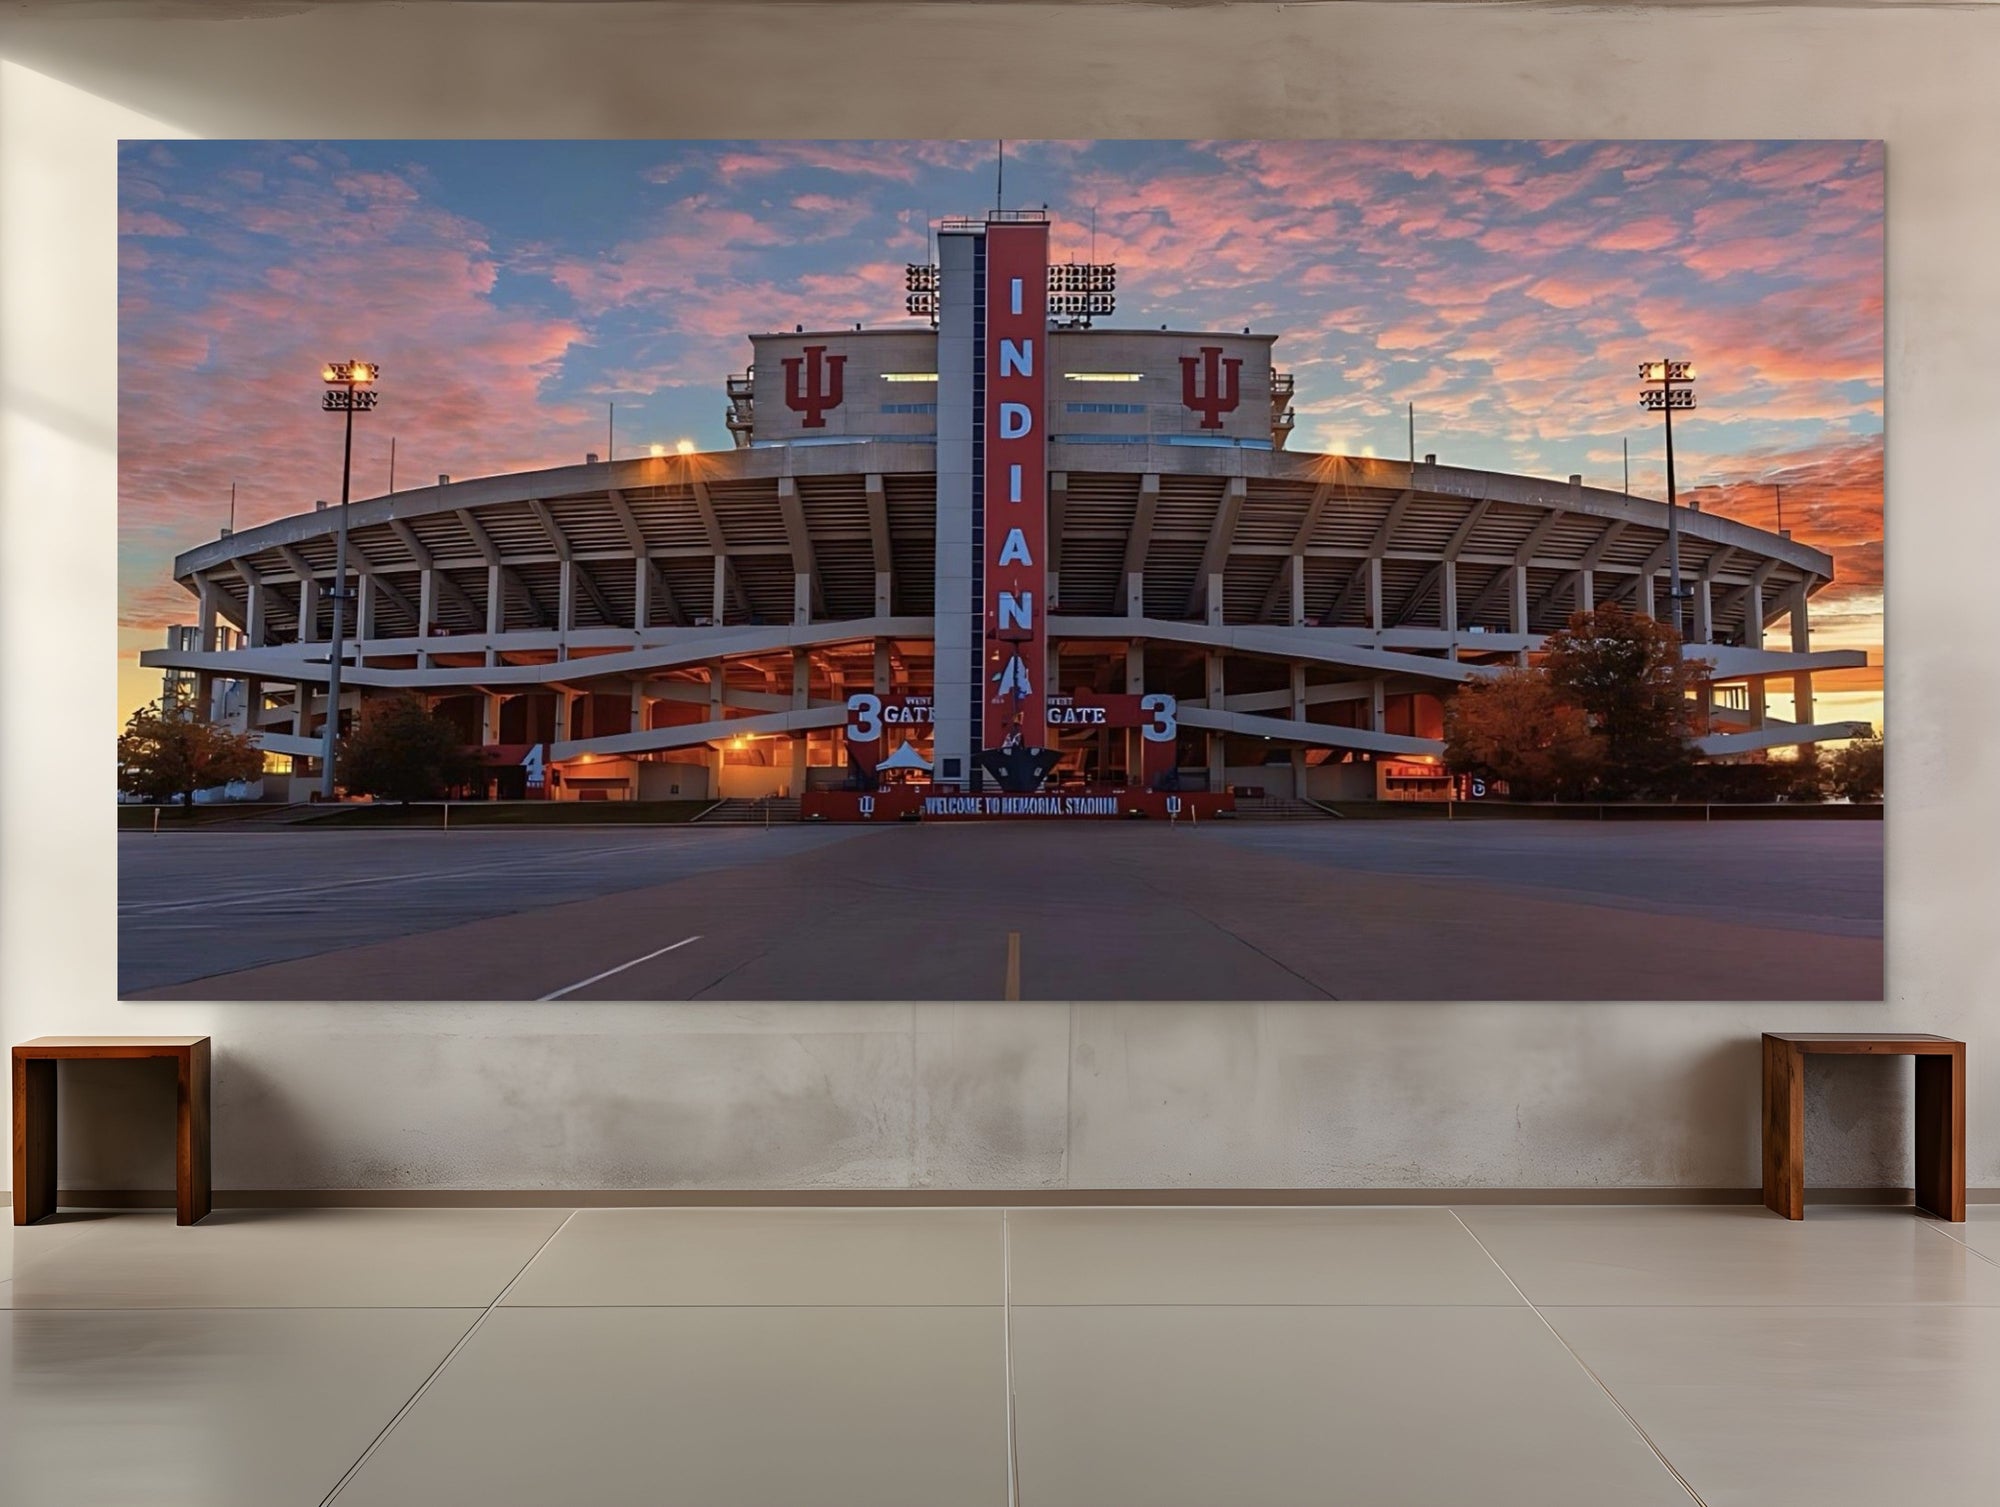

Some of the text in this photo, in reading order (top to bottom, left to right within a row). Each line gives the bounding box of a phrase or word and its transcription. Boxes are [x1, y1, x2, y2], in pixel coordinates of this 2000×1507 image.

[998, 278, 1034, 696] INDIANA
[847, 693, 882, 742] 3
[1047, 707, 1106, 724] GATE
[1140, 693, 1177, 742] 3
[520, 743, 545, 782] 4
[925, 797, 1119, 815] WELCOME TO MEMORIAL STADIUM
